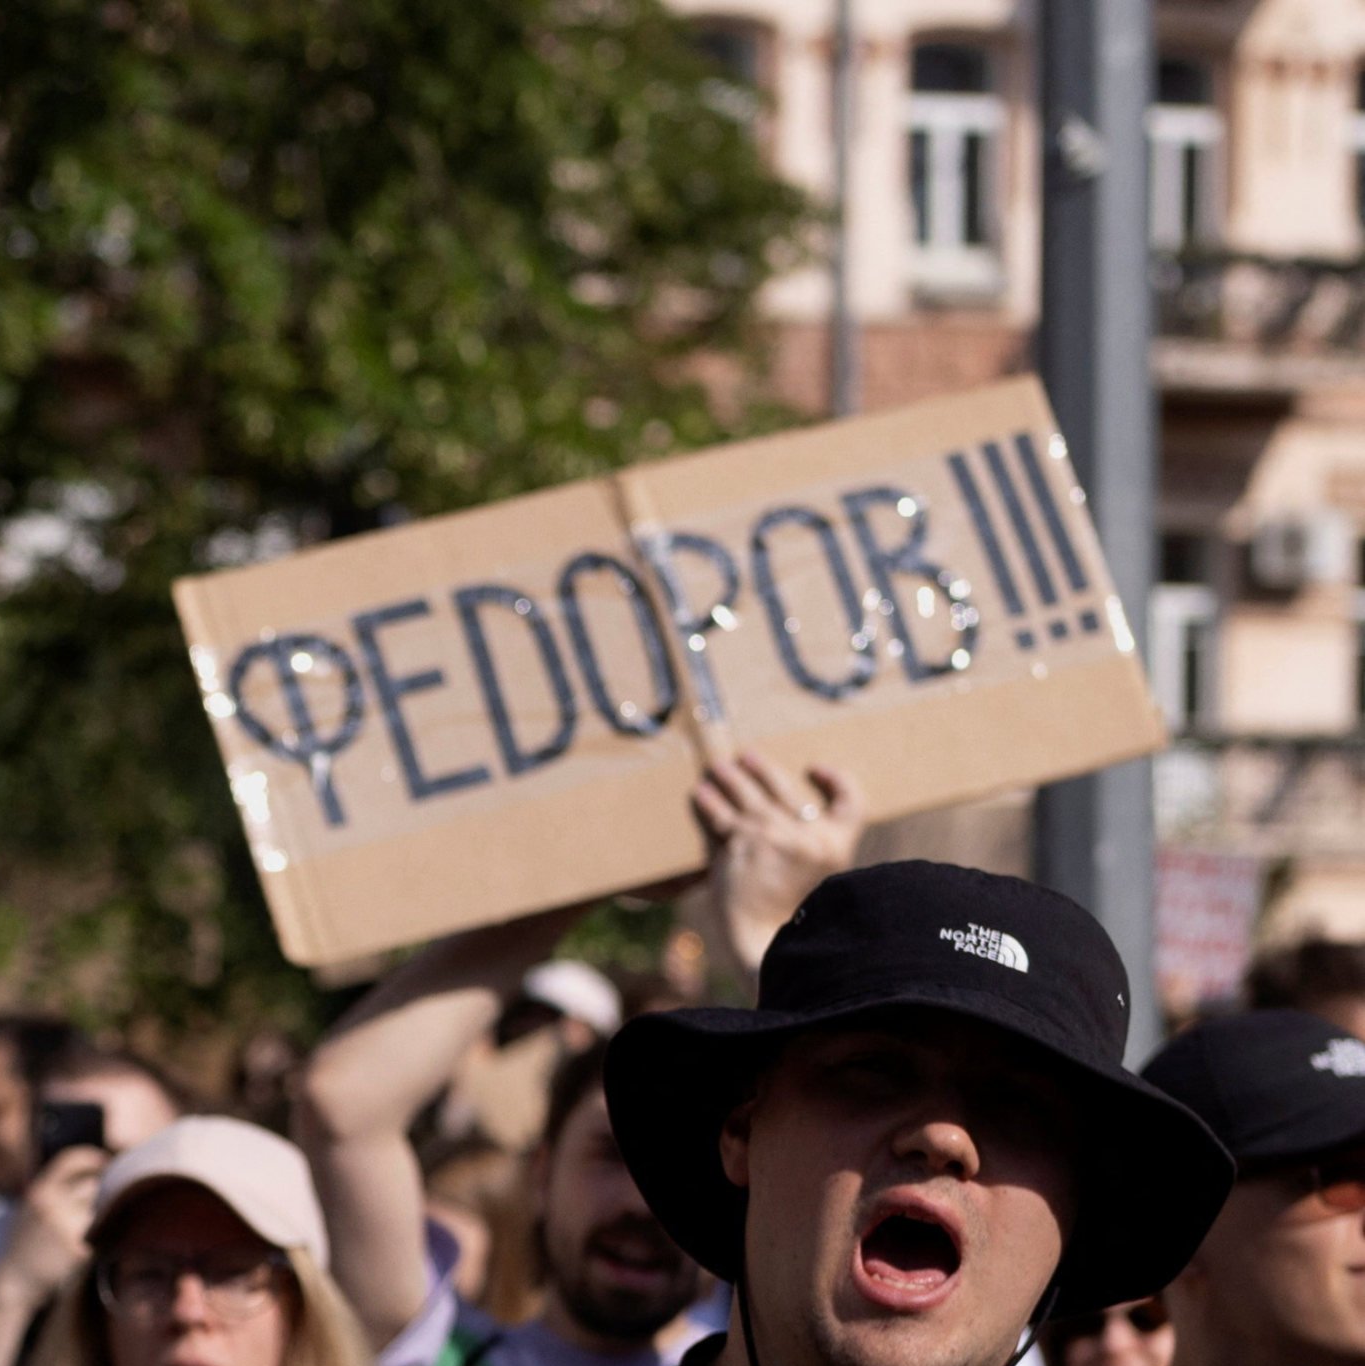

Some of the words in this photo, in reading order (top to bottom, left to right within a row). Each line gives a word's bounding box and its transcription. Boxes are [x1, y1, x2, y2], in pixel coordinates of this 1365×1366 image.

[939, 927, 1000, 952] NORTH
[968, 922, 1001, 941] THE
[954, 939, 999, 961] FACE
